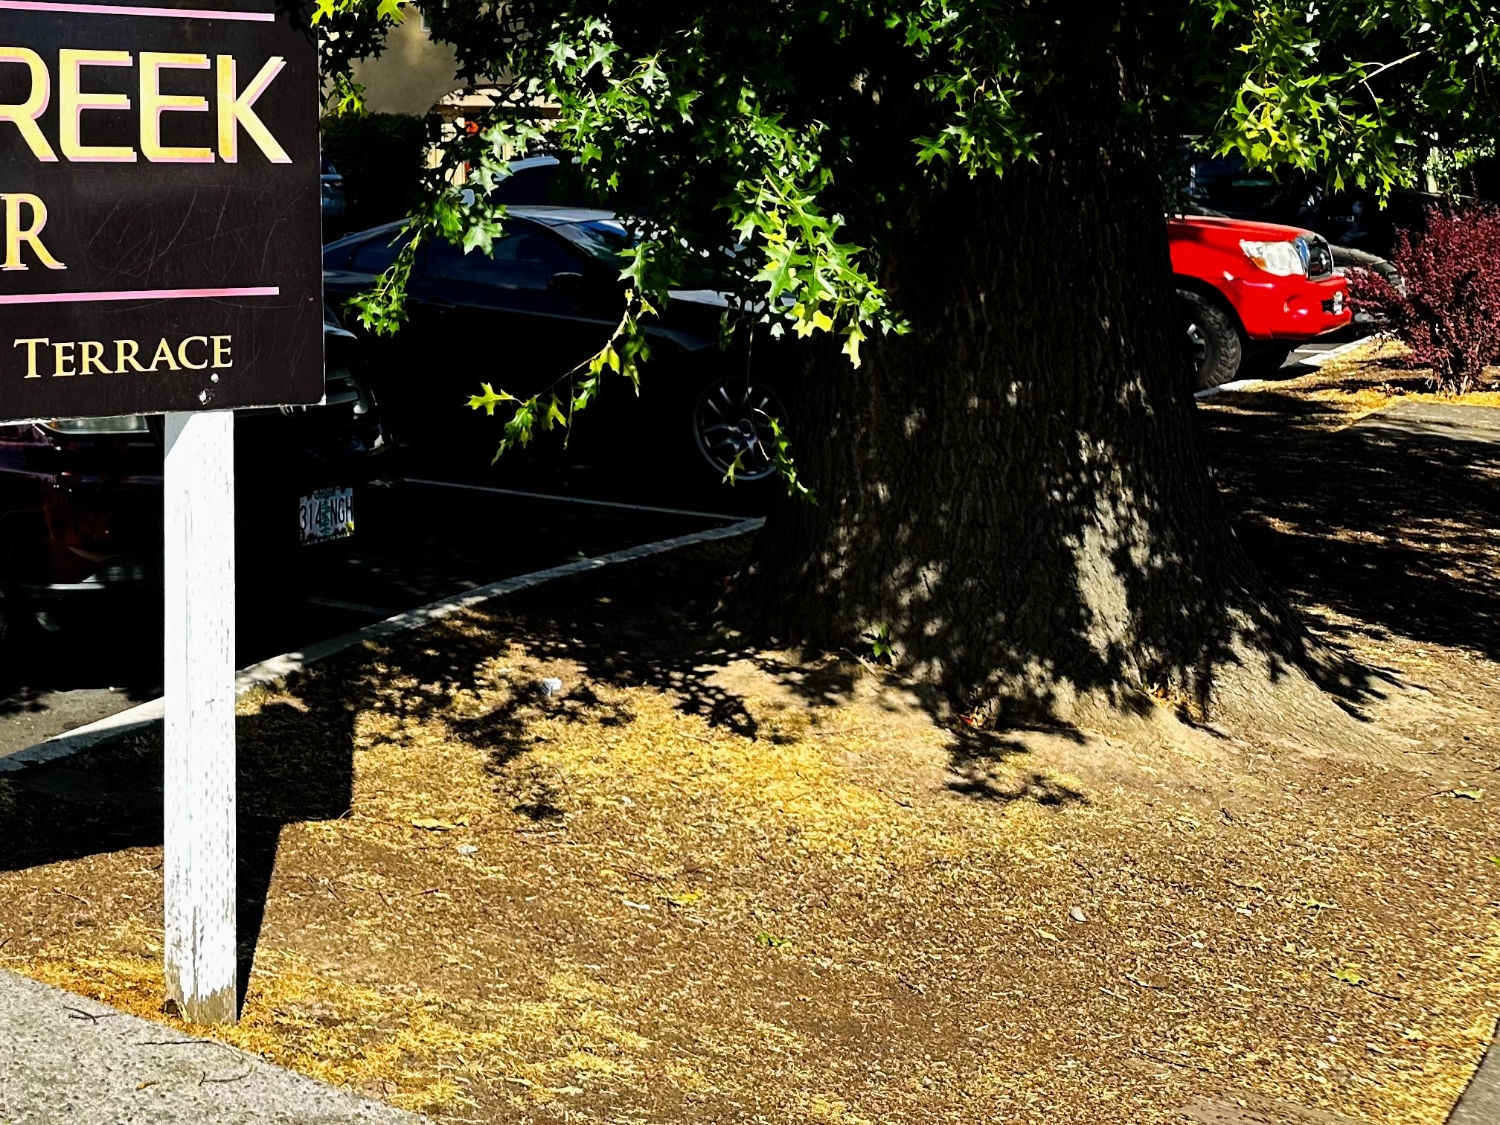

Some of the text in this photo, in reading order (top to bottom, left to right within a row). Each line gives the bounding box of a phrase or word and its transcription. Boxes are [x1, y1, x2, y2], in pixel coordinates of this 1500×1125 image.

[13, 334, 234, 379] TERRACE
[299, 495, 354, 531] 314 NGH
